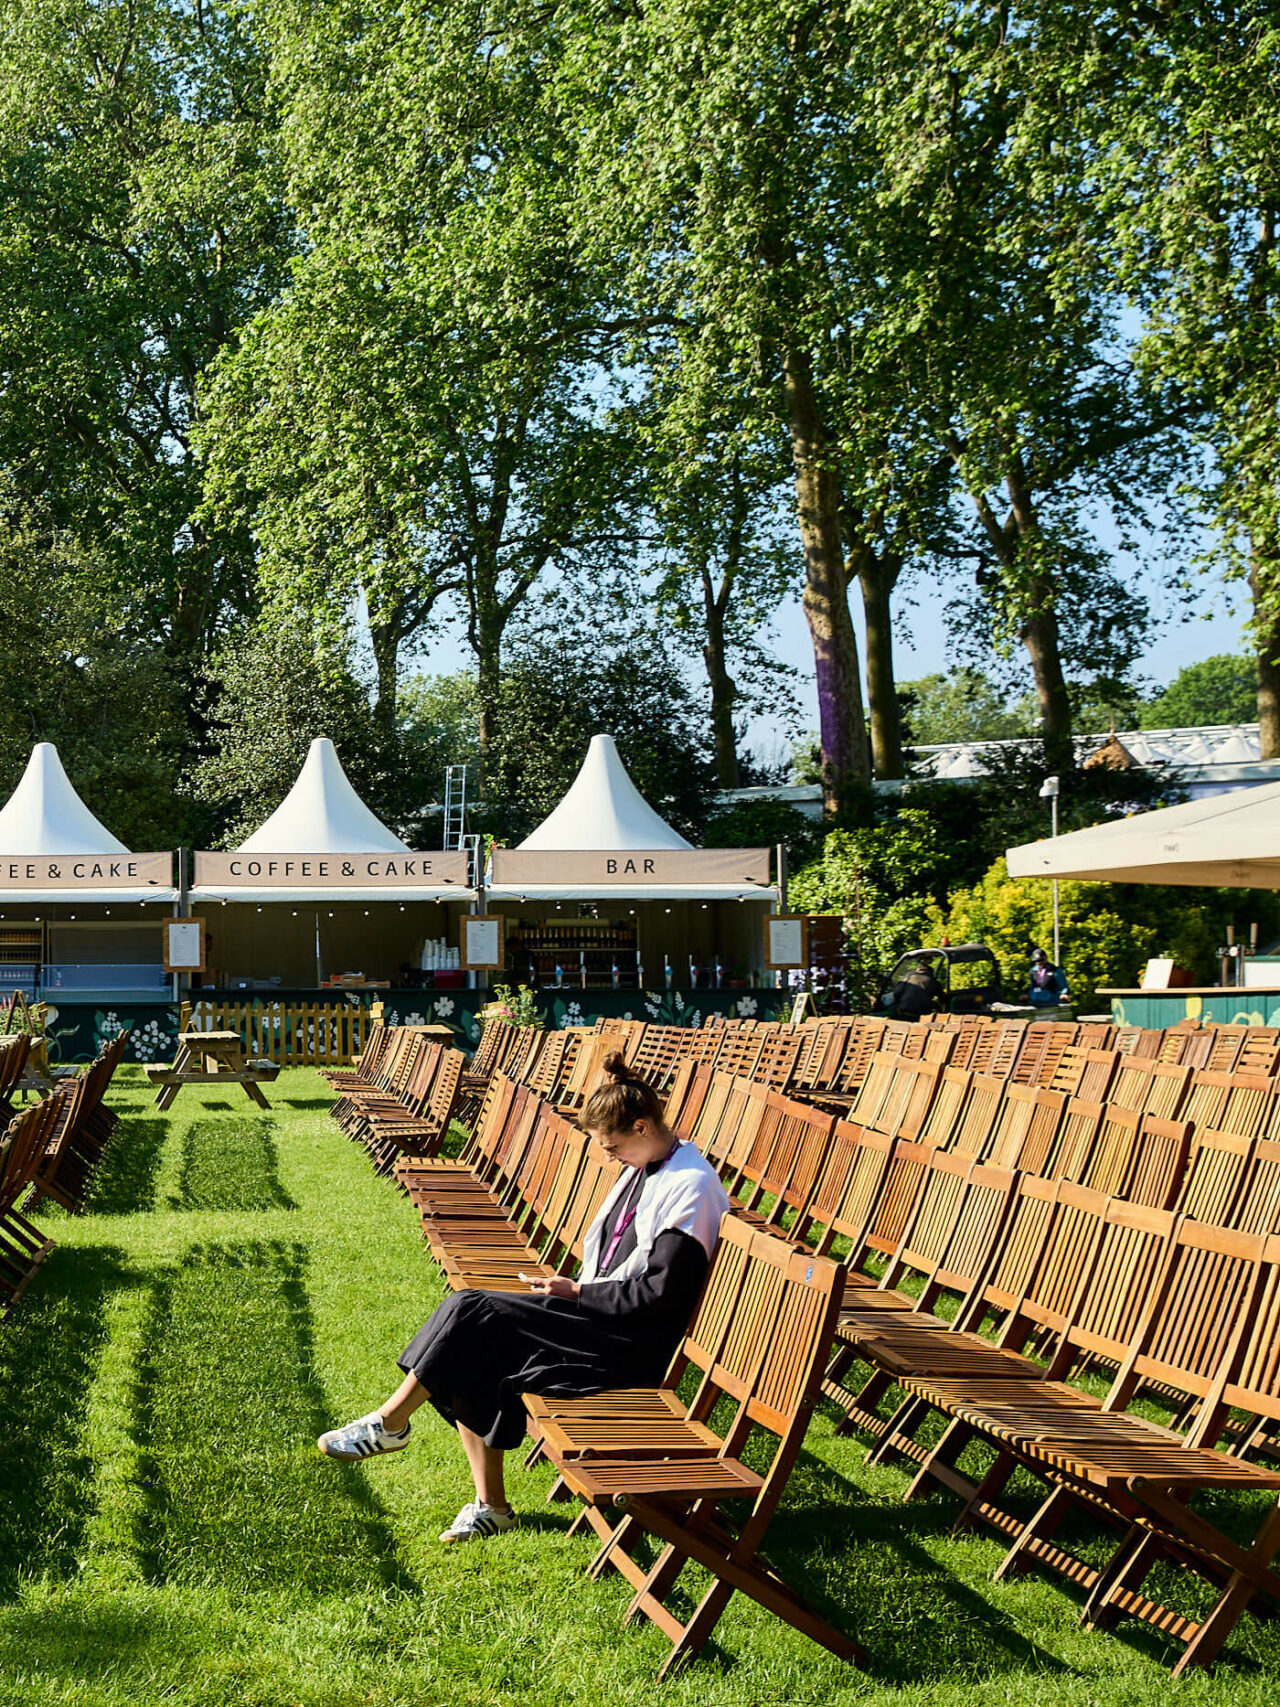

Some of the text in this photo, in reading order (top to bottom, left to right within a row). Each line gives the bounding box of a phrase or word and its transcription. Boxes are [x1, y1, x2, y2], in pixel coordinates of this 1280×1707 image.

[47, 863, 62, 879] &
[72, 862, 138, 878] CAKE
[229, 861, 329, 877] COFFEE
[341, 862, 355, 877] &
[366, 860, 433, 876] CAKE
[606, 858, 656, 874] BAR
